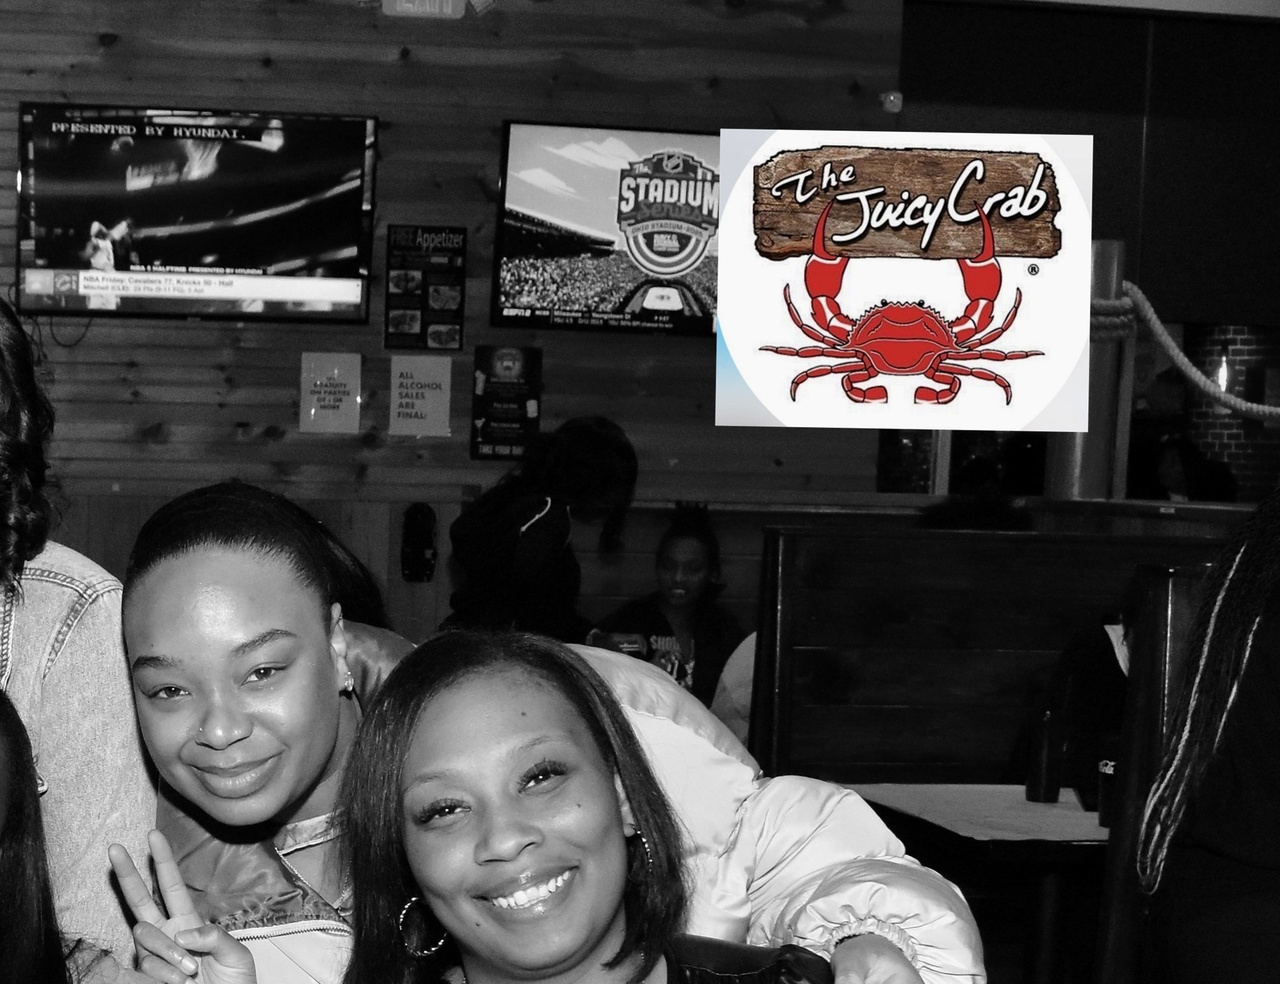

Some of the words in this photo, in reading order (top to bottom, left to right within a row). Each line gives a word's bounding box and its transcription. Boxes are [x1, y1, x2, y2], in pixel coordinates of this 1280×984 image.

[145, 125, 164, 137] BY
[620, 176, 720, 219] STADIUM
[416, 228, 464, 254] Appetizer
[398, 371, 414, 380] ALL
[398, 381, 443, 391] ALCOHOL
[398, 391, 426, 401] SALES
[397, 401, 416, 410] ARE
